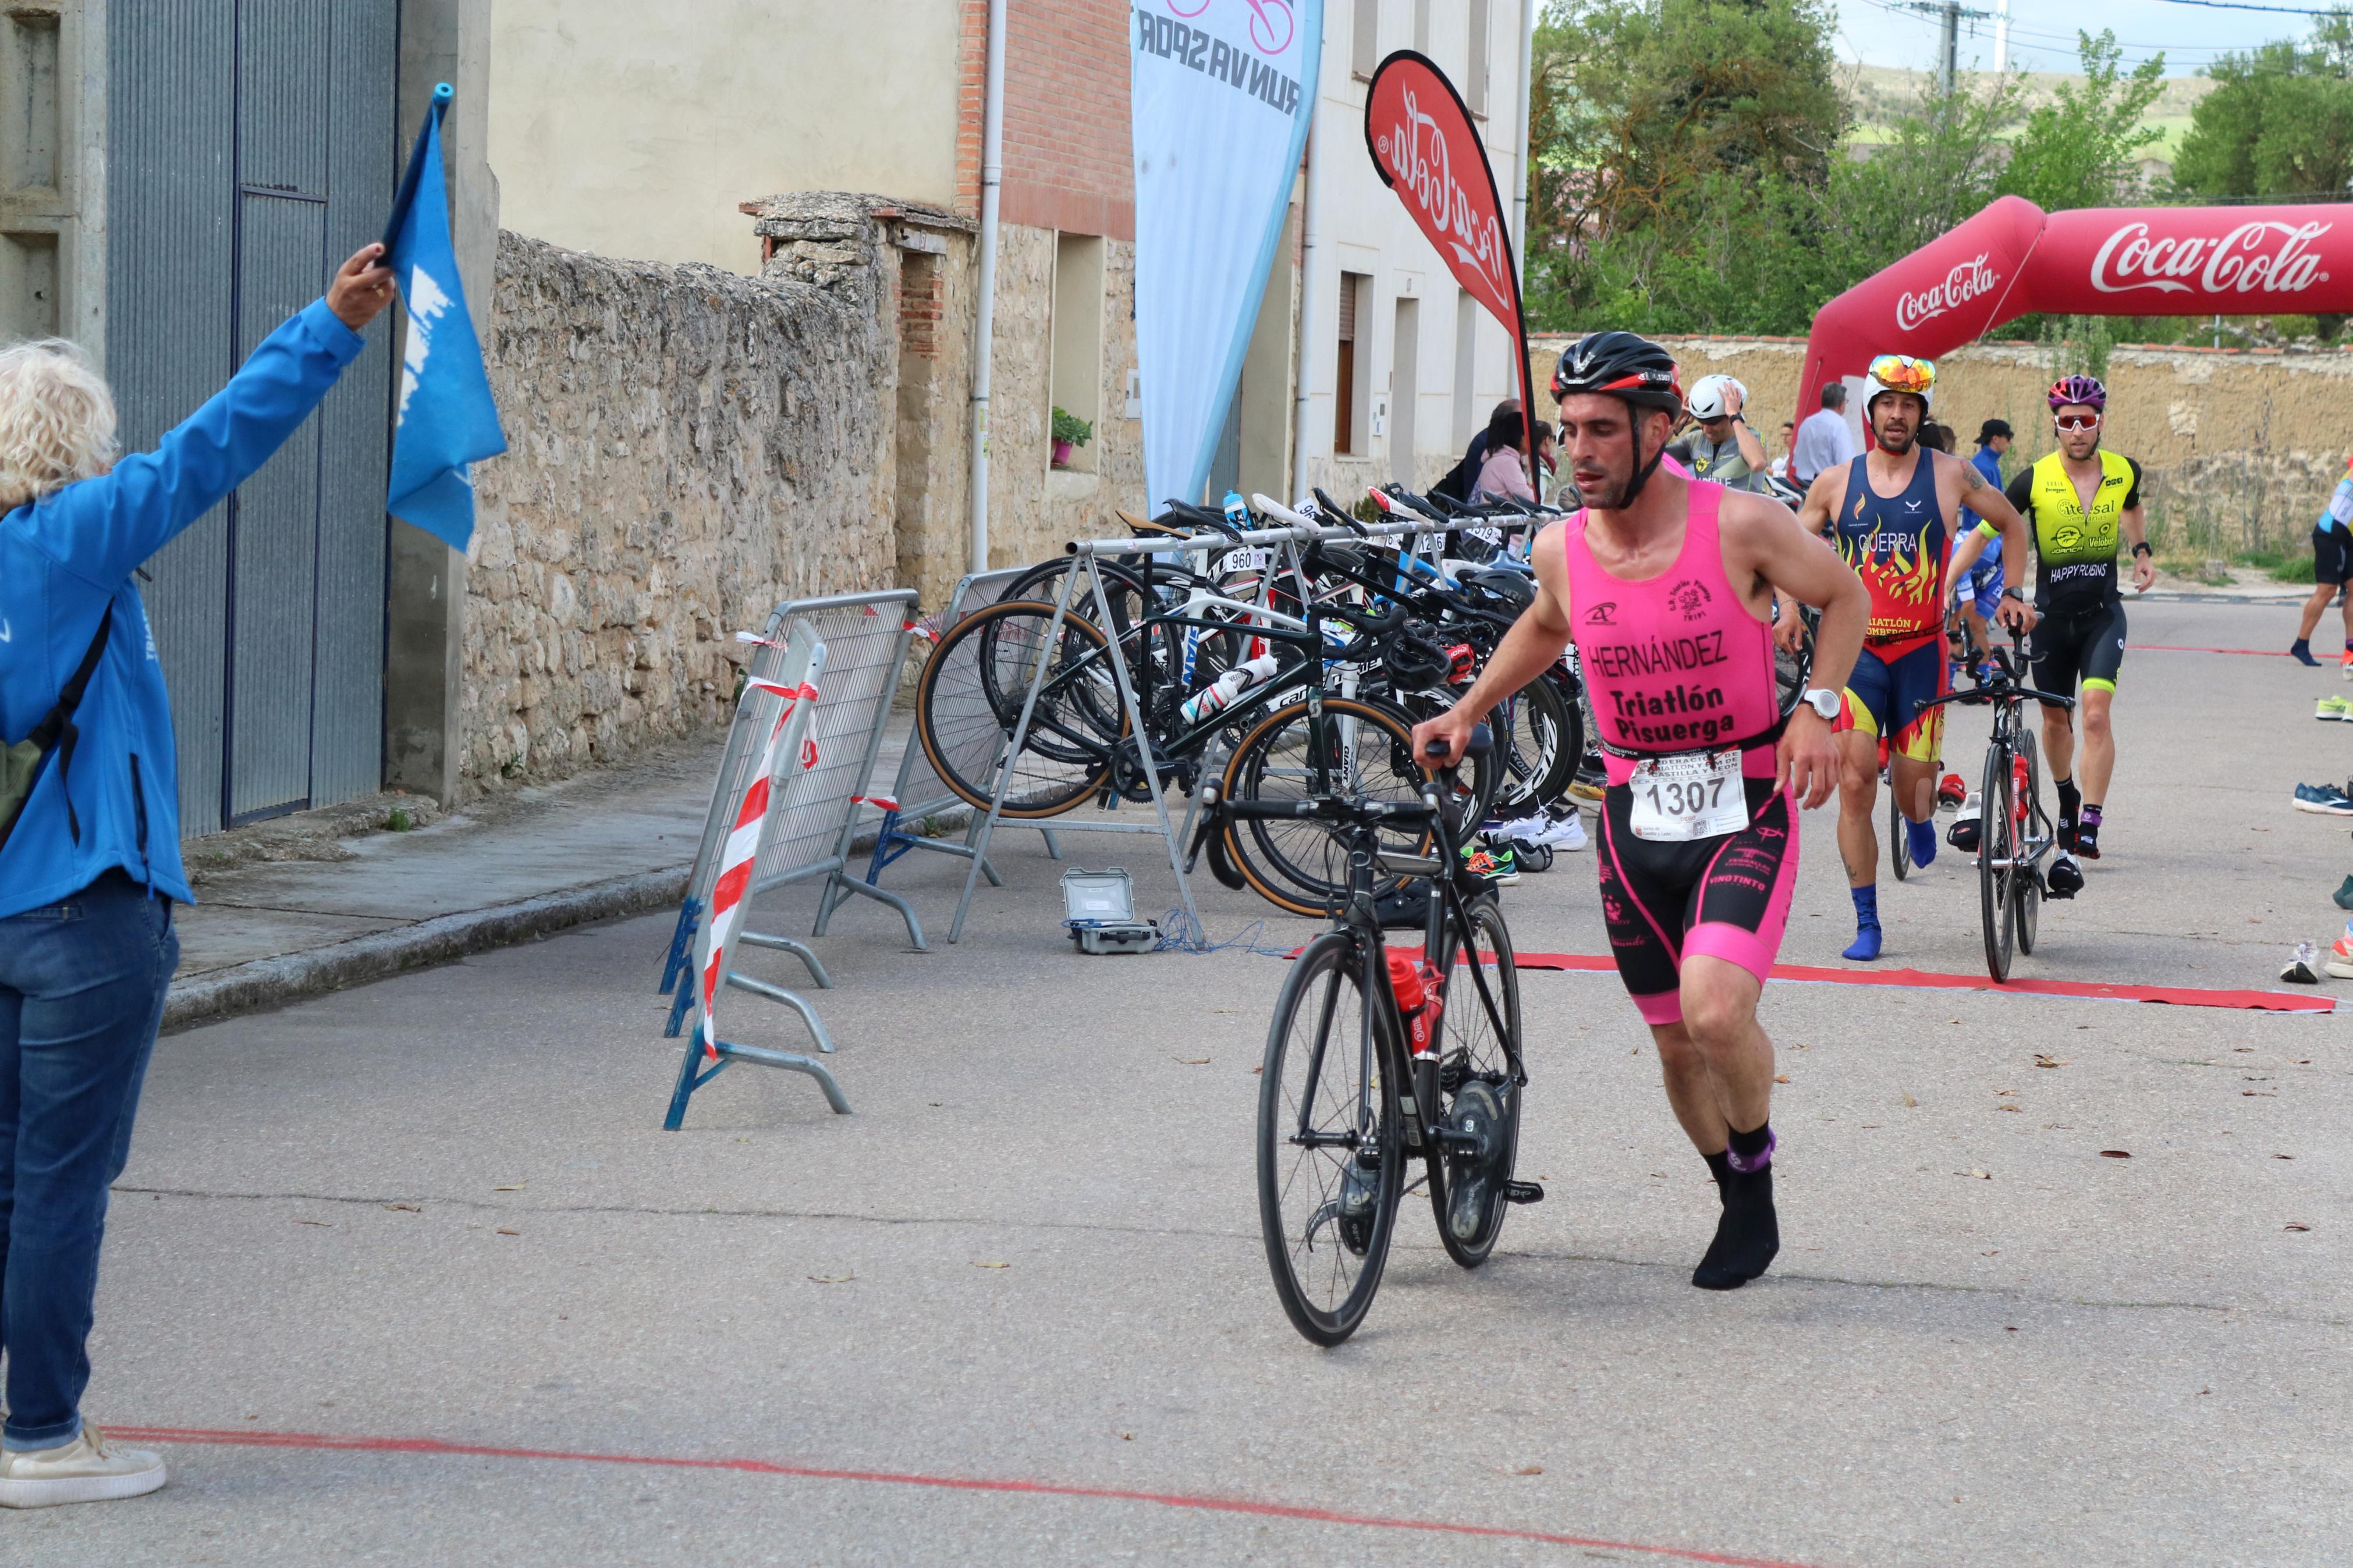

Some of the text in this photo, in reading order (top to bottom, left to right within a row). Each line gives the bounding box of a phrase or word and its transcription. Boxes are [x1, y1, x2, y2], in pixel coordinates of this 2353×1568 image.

[2091, 221, 2333, 293] Coca-Cola
[1896, 251, 1995, 331] Coca-Cola
[1858, 532, 1918, 552] GUERRA
[1232, 552, 1251, 569] 960
[1588, 630, 1728, 678] HERNÁNDEZ
[1610, 684, 1724, 717] Triatlón
[1614, 715, 1734, 744] Pisuerga
[1646, 777, 1725, 816] 1307
